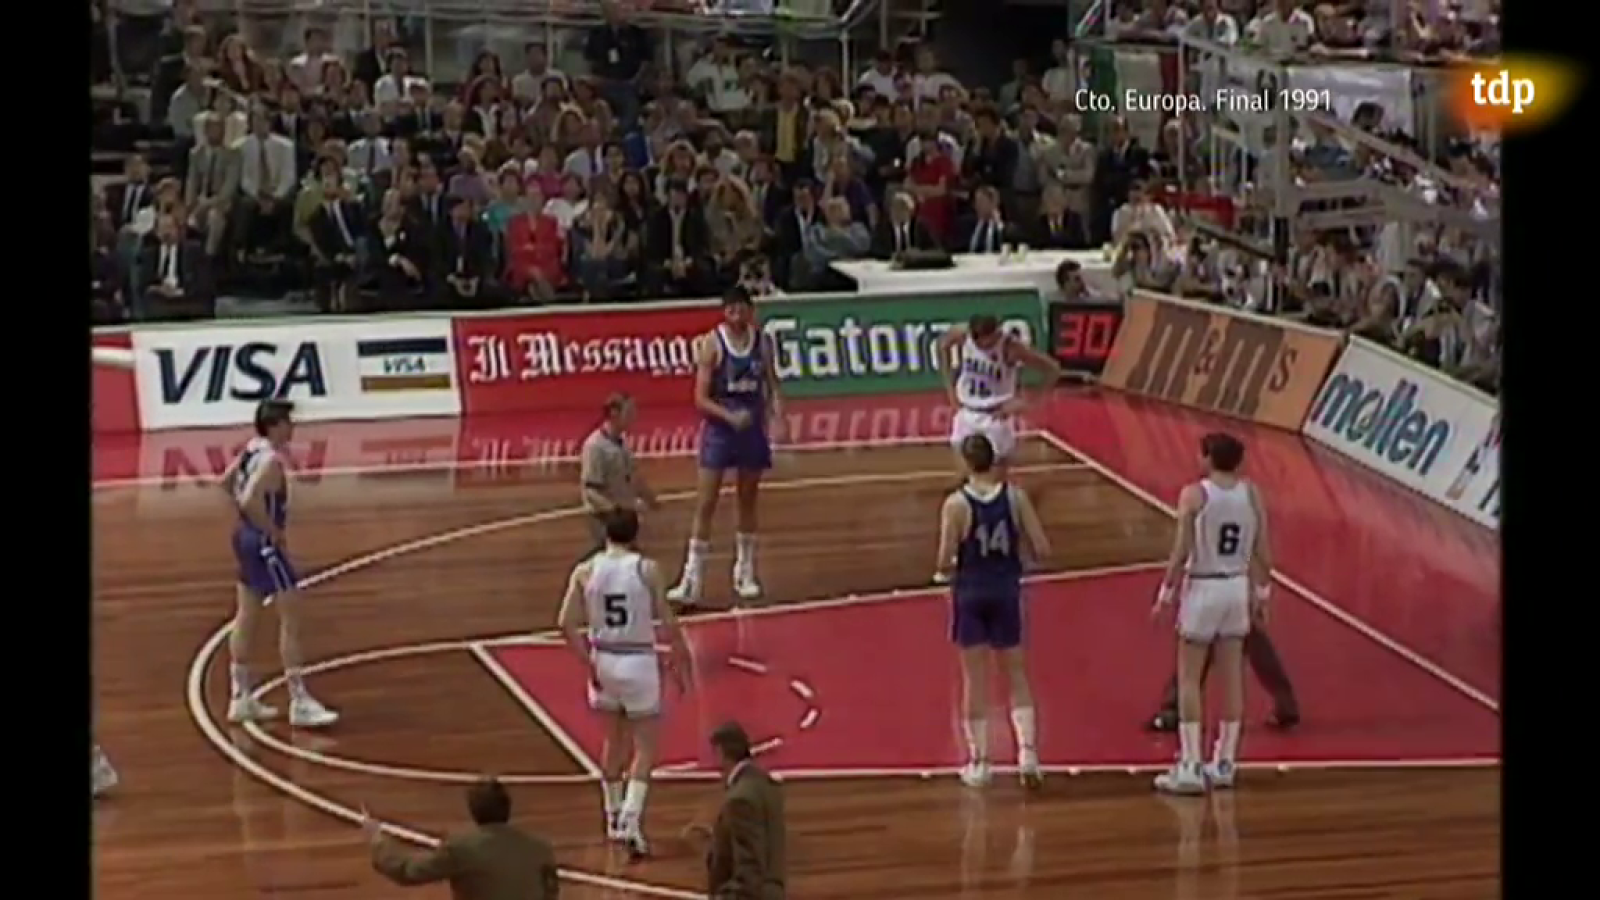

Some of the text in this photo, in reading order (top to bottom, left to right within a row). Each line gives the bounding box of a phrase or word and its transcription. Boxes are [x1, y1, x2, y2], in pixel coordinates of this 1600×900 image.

[1056, 312, 1113, 357] 30
[153, 341, 327, 404] VISA
[383, 356, 427, 374] VISA
[517, 331, 709, 381] Messagge
[1311, 373, 1450, 476] molten
[975, 519, 1011, 557] 14
[1217, 522, 1241, 556] 6
[604, 593, 629, 628] 5
